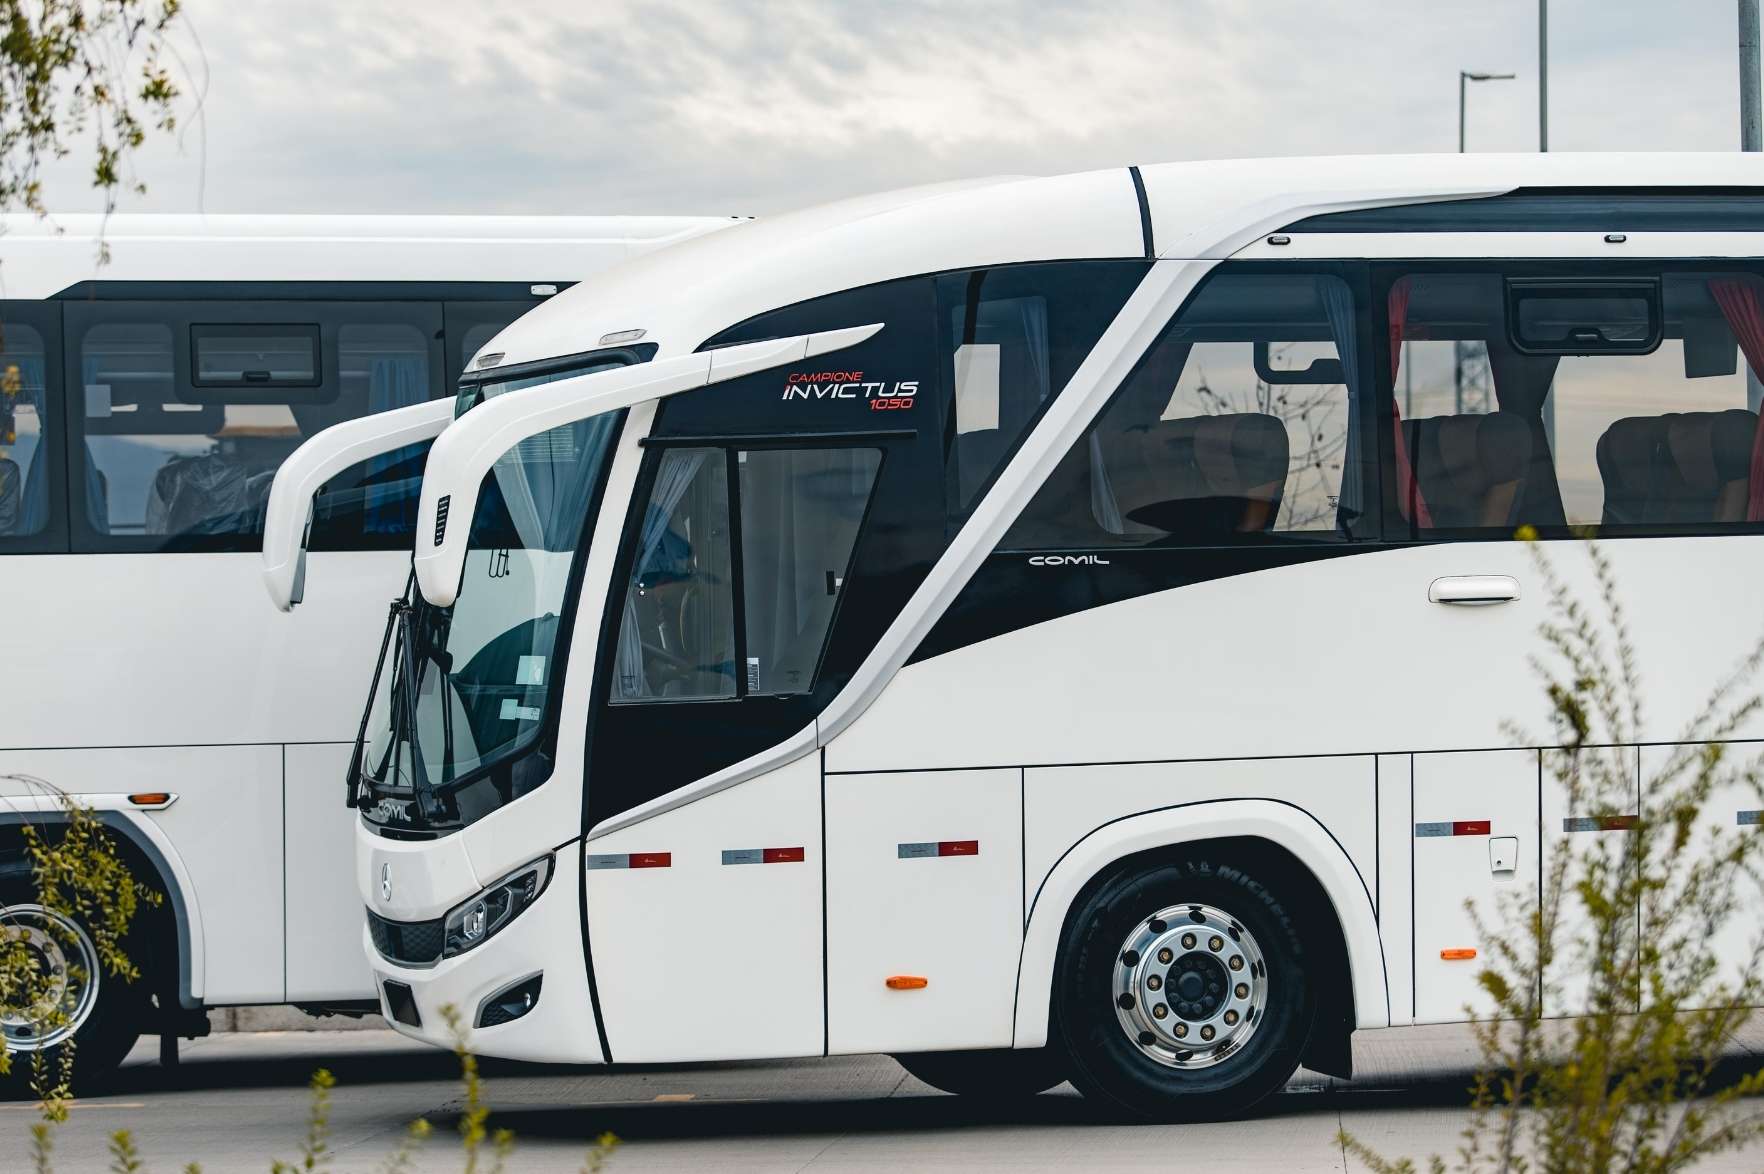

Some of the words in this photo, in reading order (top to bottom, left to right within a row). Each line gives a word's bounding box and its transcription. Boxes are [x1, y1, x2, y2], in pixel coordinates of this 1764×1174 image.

[788, 371, 864, 383] CAMPIONE
[782, 381, 919, 400] INVICTUS
[869, 398, 913, 410] 1050
[1028, 555, 1110, 566] COMIL
